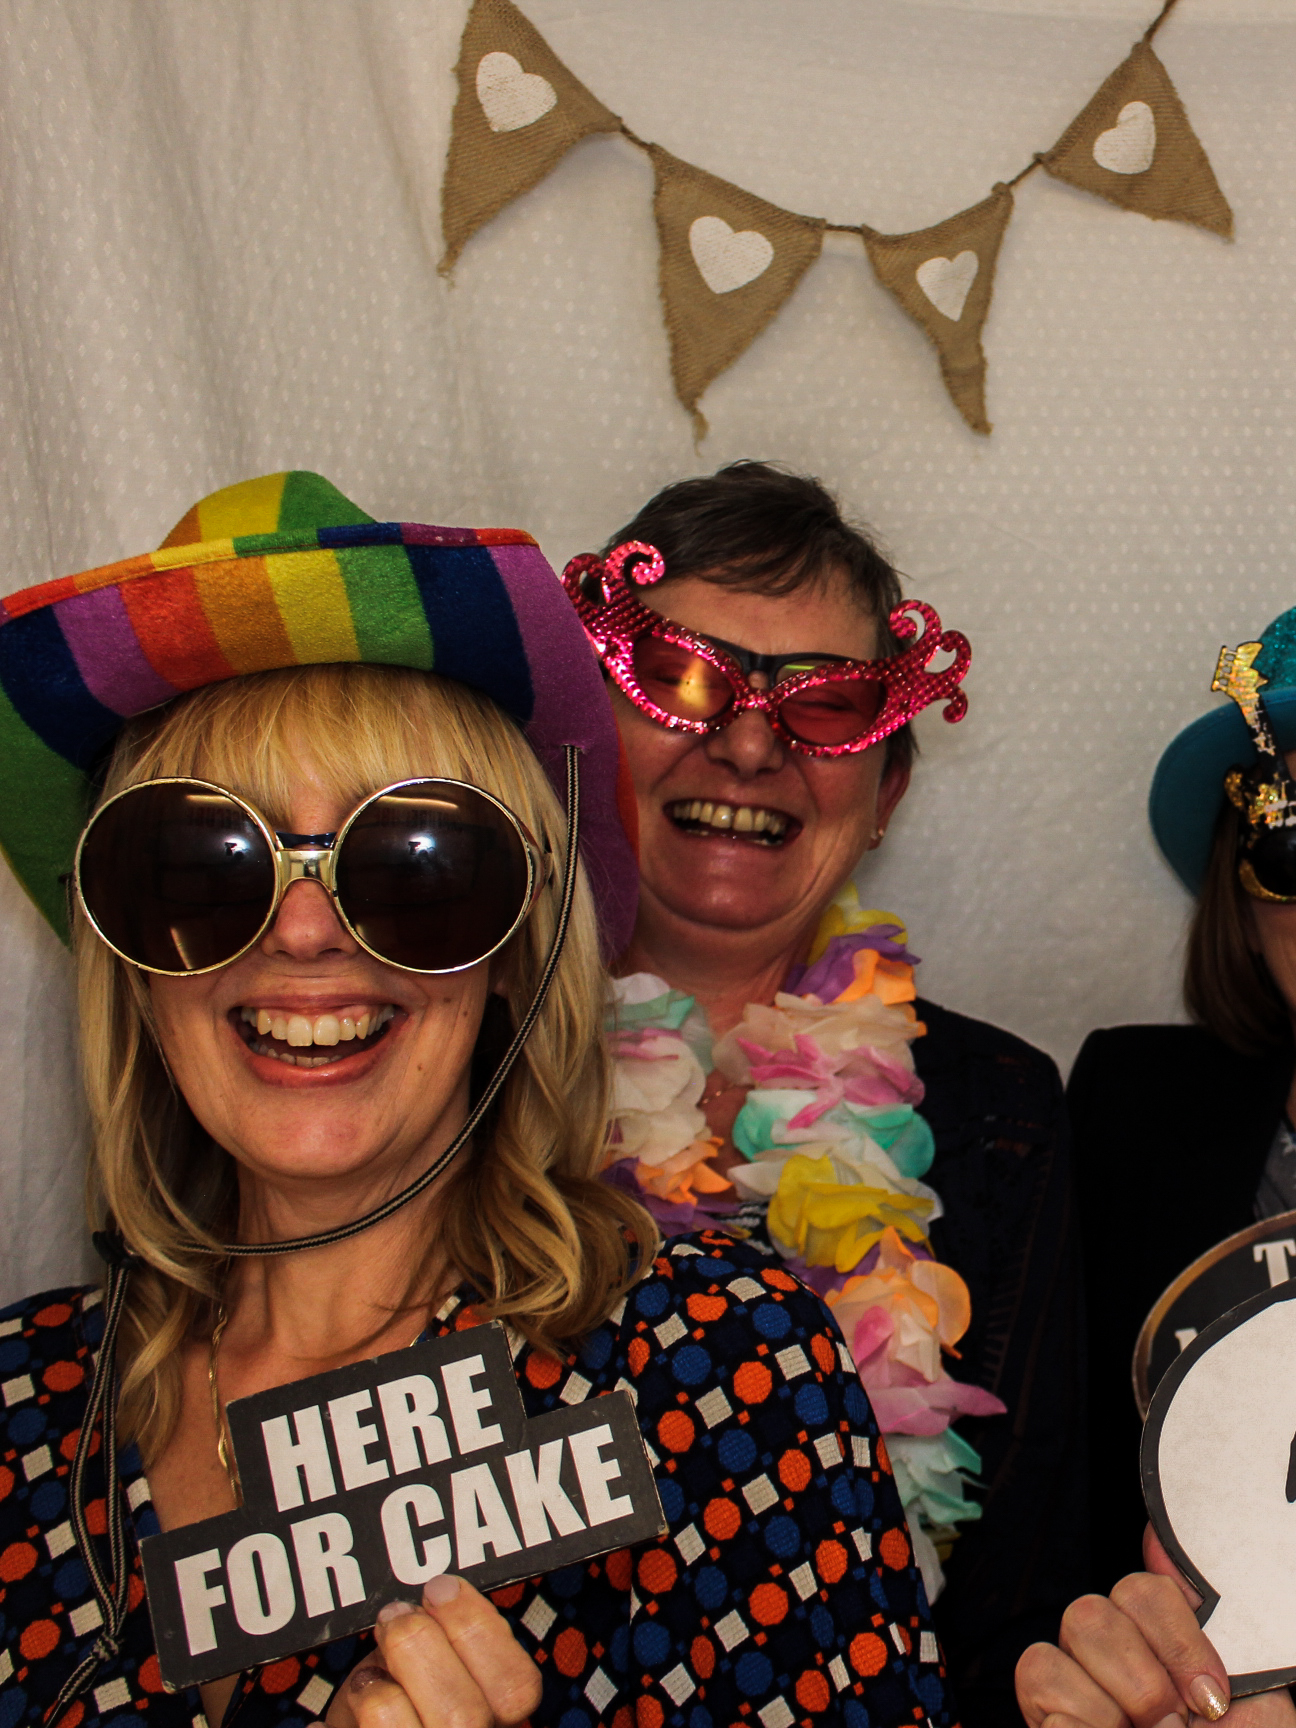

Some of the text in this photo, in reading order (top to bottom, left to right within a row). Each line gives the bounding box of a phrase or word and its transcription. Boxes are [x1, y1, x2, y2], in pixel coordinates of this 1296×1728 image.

[260, 1353, 504, 1512] HERE
[174, 1424, 635, 1657] FOR CAKE
